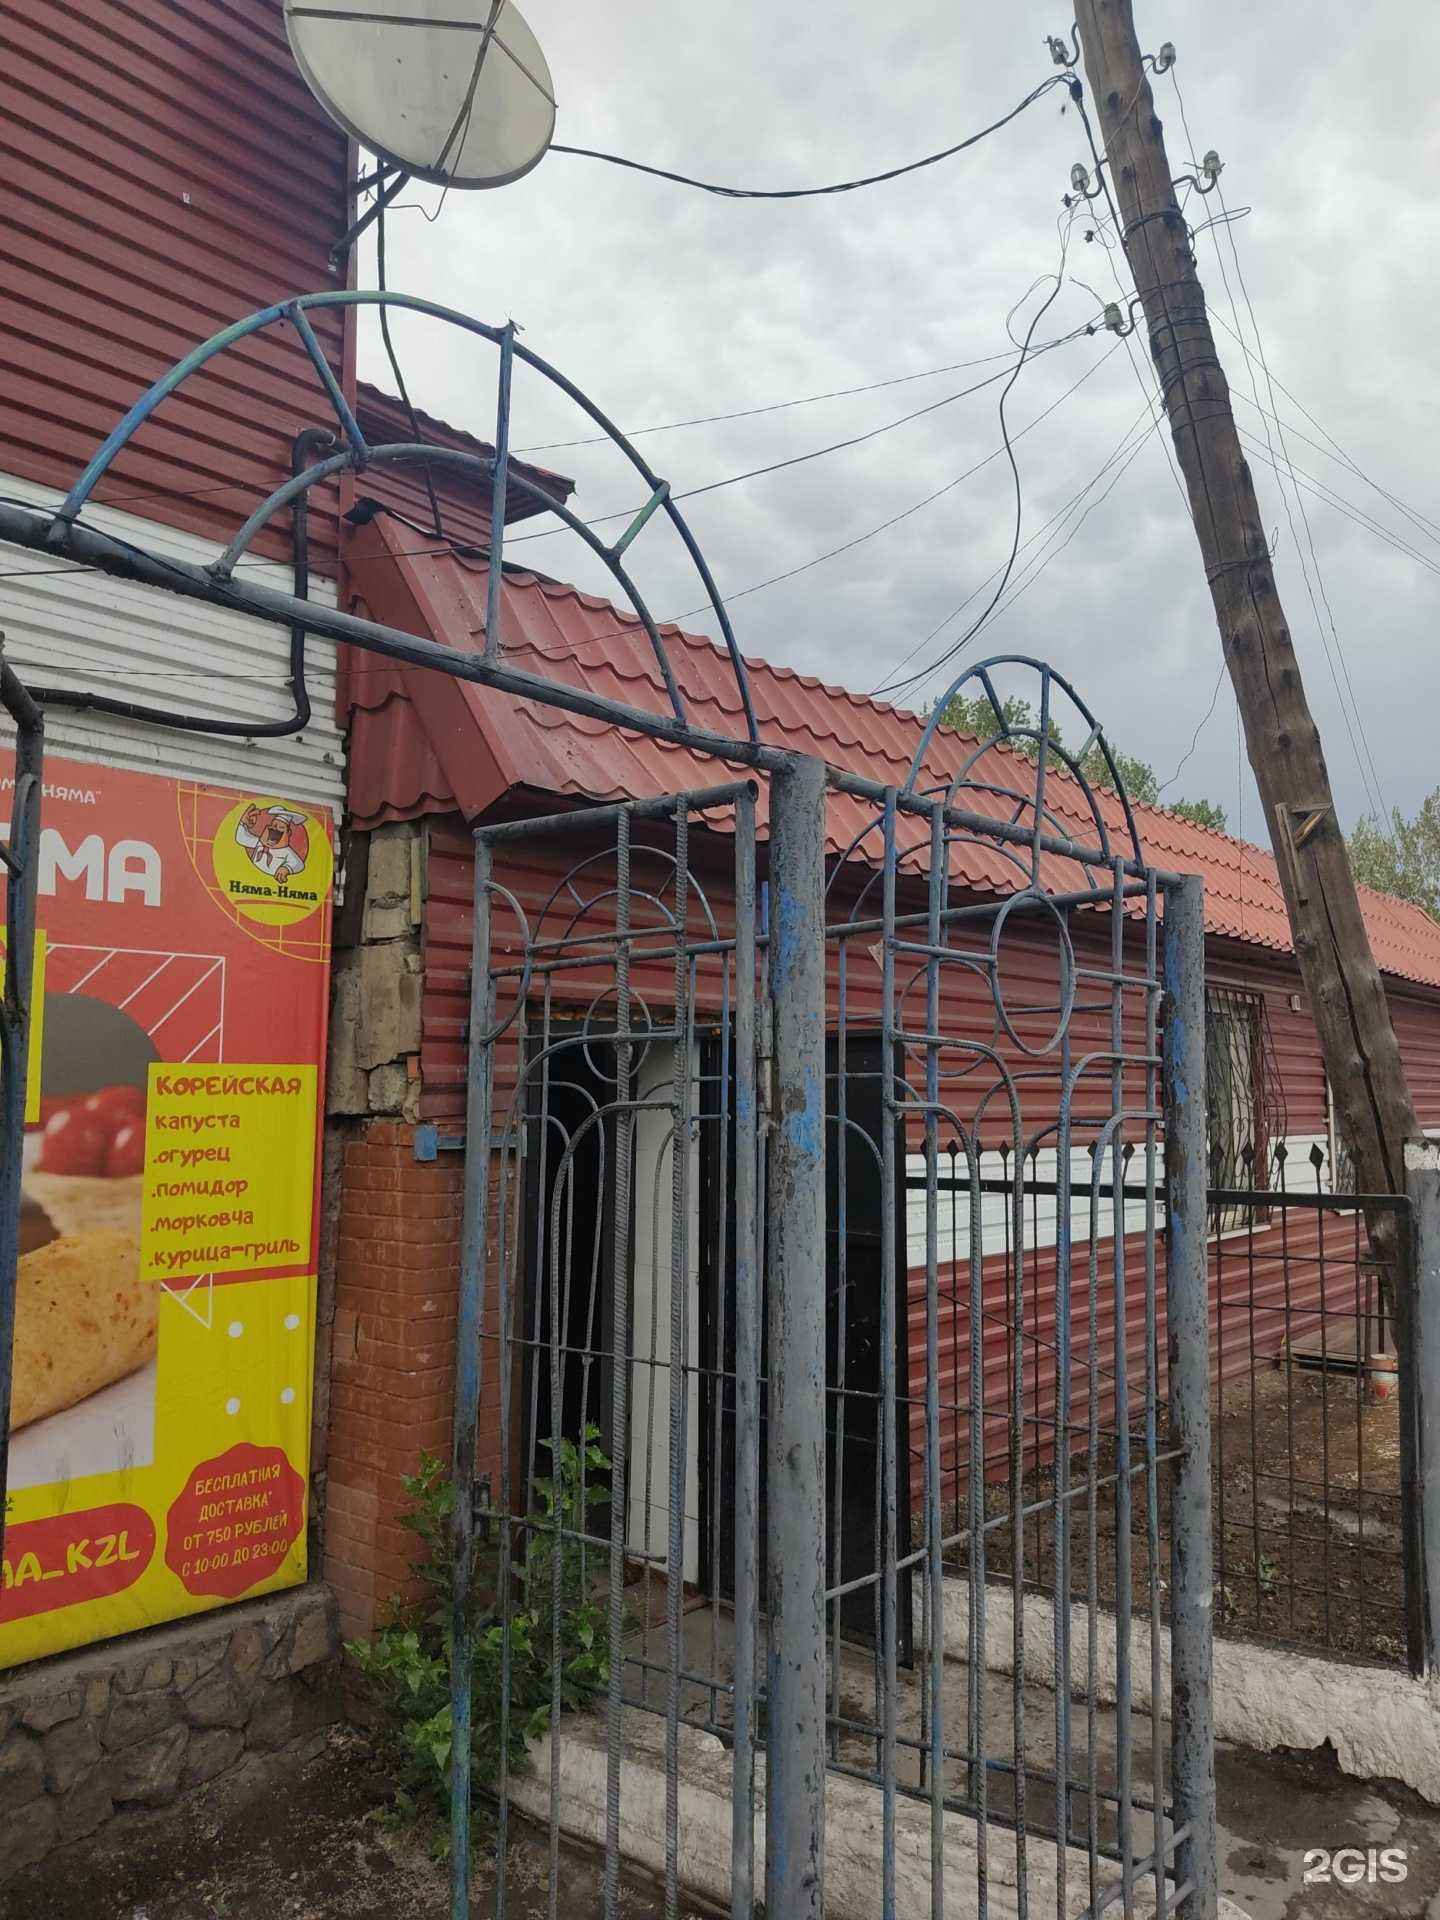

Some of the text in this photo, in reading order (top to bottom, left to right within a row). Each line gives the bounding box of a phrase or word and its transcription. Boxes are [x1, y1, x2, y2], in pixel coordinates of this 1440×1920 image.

[229, 880, 318, 901] Няма-Няма
[156, 1075, 302, 1096] КОРЕЙСКАЯ
[155, 1114, 240, 1133] капуста
[195, 1464, 281, 1496] БЕСПЛАТНАЯ
[183, 1509, 288, 1551] ОТ 750 РУБЛЕЙ
[182, 1560, 190, 1577] С
[232, 1547, 250, 1566] ДО
